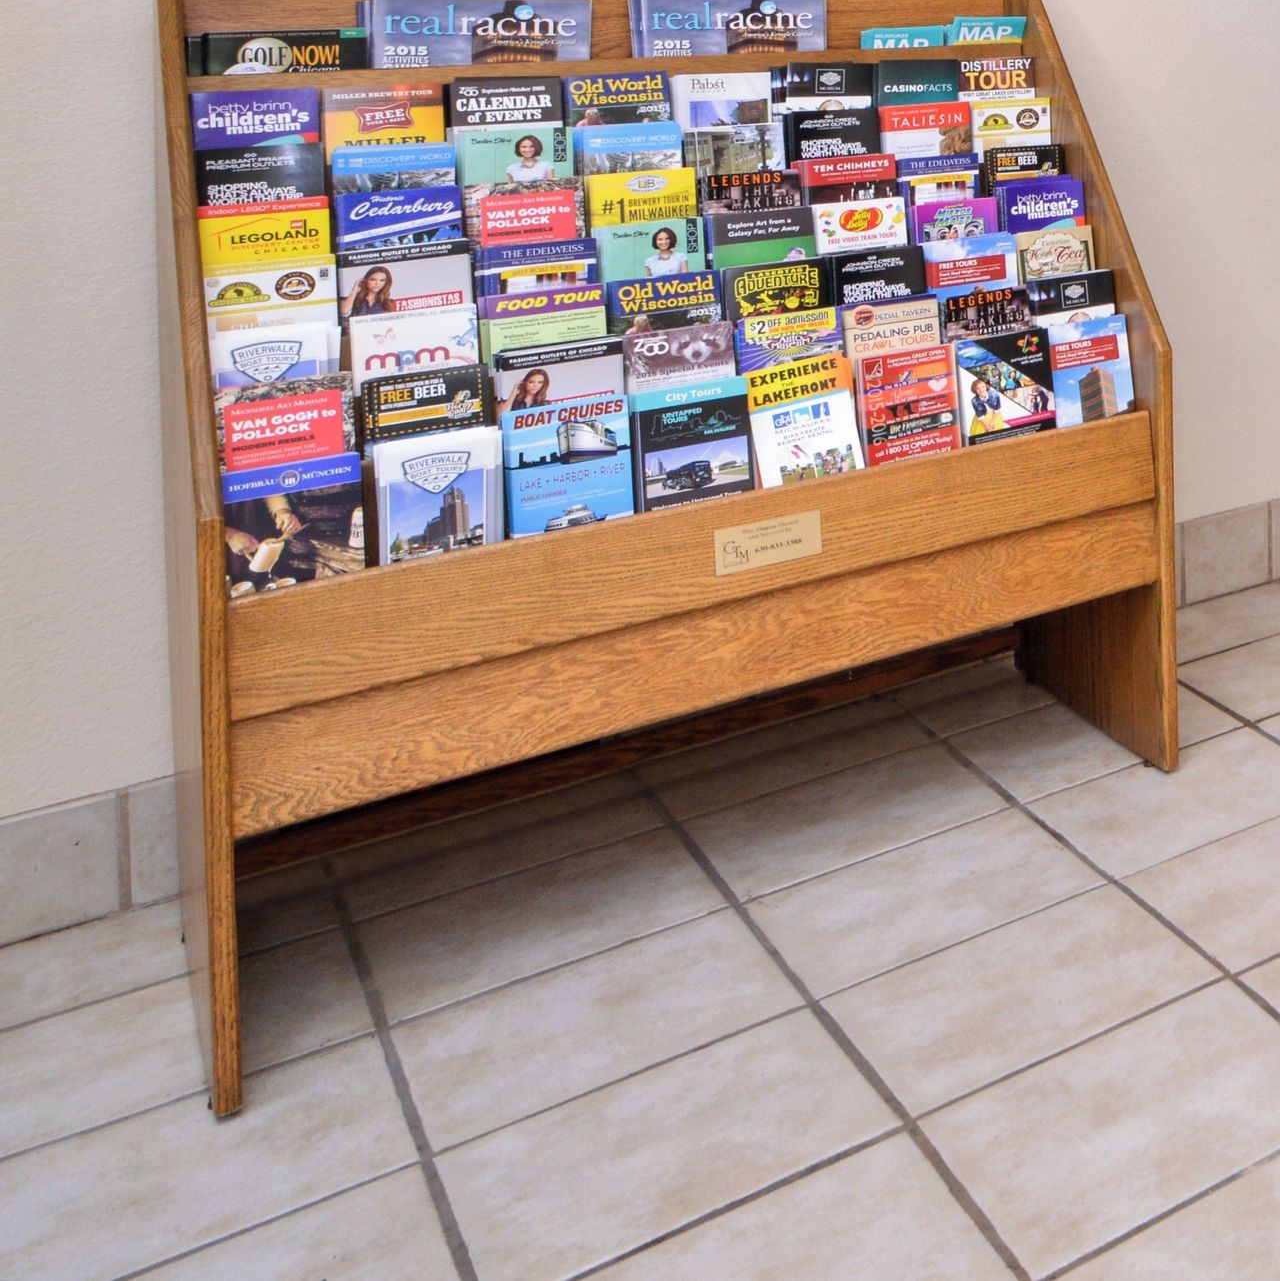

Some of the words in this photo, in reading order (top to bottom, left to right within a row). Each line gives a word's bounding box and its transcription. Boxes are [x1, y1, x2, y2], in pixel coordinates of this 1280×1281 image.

[958, 26, 1013, 42] MAP
[383, 45, 428, 57] 2015
[653, 40, 691, 50] 2015
[241, 46, 289, 67] GOLF
[292, 44, 341, 66] NOW!
[382, 55, 430, 65] ACTIVITIES
[652, 49, 692, 58] ACTIVITIES
[960, 58, 1032, 72] DISTILLERY
[570, 77, 604, 95] Old
[608, 74, 664, 92] World
[690, 77, 726, 91] Pabst
[964, 71, 1027, 90] TOUR
[332, 92, 367, 100] MILLER
[368, 90, 410, 98] BREWERY
[571, 88, 665, 106] Wisconsin
[208, 102, 251, 115] betty
[252, 100, 293, 112] brinn
[456, 94, 553, 113] CALENDAR
[639, 104, 665, 114] 2015
[197, 108, 311, 130] children's
[364, 108, 406, 123] FREE
[467, 112, 482, 124] of
[484, 109, 543, 123] EVENTS
[892, 113, 964, 129] TALIESIN
[226, 122, 301, 136] museum
[554, 132, 567, 162] SHOP
[602, 136, 647, 144] DISCOVERY
[800, 137, 842, 149] SHOPPING
[206, 158, 256, 166] PLEASANT
[813, 164, 834, 173] TEN
[836, 159, 890, 171] CHIMNEYS
[910, 160, 926, 169] THE
[928, 156, 971, 168] EDELWEISS
[997, 157, 1017, 167] FREE
[1017, 155, 1038, 166] BEER
[207, 181, 268, 193] SHOPPING
[711, 172, 781, 188] LEGENDS
[251, 185, 297, 196] ALWAYS
[1017, 193, 1042, 204] betty
[1043, 190, 1068, 200] brinn
[208, 208, 240, 216] Indoor
[272, 200, 321, 212] Experience
[349, 197, 456, 221] Cedarburg
[628, 197, 661, 208] BREWERY
[1010, 197, 1079, 216] children's
[487, 209, 516, 220] VAN
[518, 205, 557, 217] GOGH
[558, 204, 571, 213] to
[602, 198, 626, 224] #1
[628, 204, 690, 222] MILWAUKEE
[1027, 209, 1074, 221] museum
[487, 215, 550, 230] POLLOCK
[727, 220, 755, 230] Explore
[769, 218, 786, 226] from
[230, 219, 319, 245] LEGOLAND
[687, 223, 698, 253] SHOP
[728, 229, 753, 238] Galaxy
[781, 224, 801, 233] Away
[842, 234, 860, 244] VIDEO
[860, 232, 879, 241] TRAIN
[879, 230, 898, 240] TOURS
[254, 243, 321, 255] CHICAGO
[348, 252, 380, 261] FASHION
[381, 248, 410, 258] OUTLETS
[501, 250, 524, 259] THE
[526, 243, 585, 257] EDELWEISS
[1054, 244, 1086, 263] Tea
[939, 261, 954, 270] FREE
[955, 259, 979, 268] TOURS
[618, 283, 654, 301] Old
[658, 275, 715, 294] World
[735, 268, 819, 297] ADVENTURE
[843, 280, 885, 291] SHOPPING
[396, 292, 461, 312] FASHIONISTAS
[496, 296, 549, 313] FOOD
[553, 289, 603, 304] TOUR
[620, 292, 715, 314] Wisconsin
[949, 289, 1013, 310] LEGENDS
[690, 308, 716, 316] 2015
[901, 307, 931, 317] TAVERN
[750, 319, 766, 336] $2
[767, 317, 783, 329] OFF
[853, 326, 910, 343] PEDALING
[913, 322, 934, 334] PUB
[237, 343, 296, 360] RIVERWALK
[854, 339, 895, 354] CRAWL
[900, 333, 936, 346] TOURS
[1055, 343, 1070, 353] FREE
[1071, 340, 1093, 350] TOURS
[239, 357, 265, 368] BOAT
[266, 354, 296, 364] TOURS
[508, 354, 539, 365] FASHION
[540, 350, 567, 360] OUTLETS
[635, 368, 658, 380] 2015
[659, 364, 696, 377] Special
[697, 359, 730, 371] Events
[749, 358, 839, 389] EXPERIENCE
[380, 388, 412, 404] FREE
[414, 383, 447, 399] BEER
[665, 392, 688, 403] City
[689, 386, 723, 399] Tours
[752, 377, 838, 408] LAKEFRONT
[230, 405, 275, 416] MILWAUKEE
[293, 397, 329, 407] MUSEUM
[662, 407, 703, 419] UNTAPPED
[863, 379, 888, 447] 2015-2016
[231, 418, 269, 431] VAN
[271, 410, 319, 426] GOGH
[321, 408, 338, 418] to
[513, 409, 555, 431] BOAT
[557, 399, 625, 423] CRUISES
[662, 415, 689, 425] TOURS
[231, 422, 311, 443] POLLOCK
[231, 440, 276, 453] MODERN
[277, 434, 316, 446] REBELS
[408, 454, 464, 472] RIVERWALK
[411, 468, 432, 479] BOAT
[435, 463, 464, 473] TOURS
[229, 478, 279, 492] HOFBRÄU
[301, 465, 353, 481] MÜNCHEN
[519, 477, 543, 493] LAKE
[552, 468, 590, 484] HARBOR
[600, 462, 626, 476] RIVER
